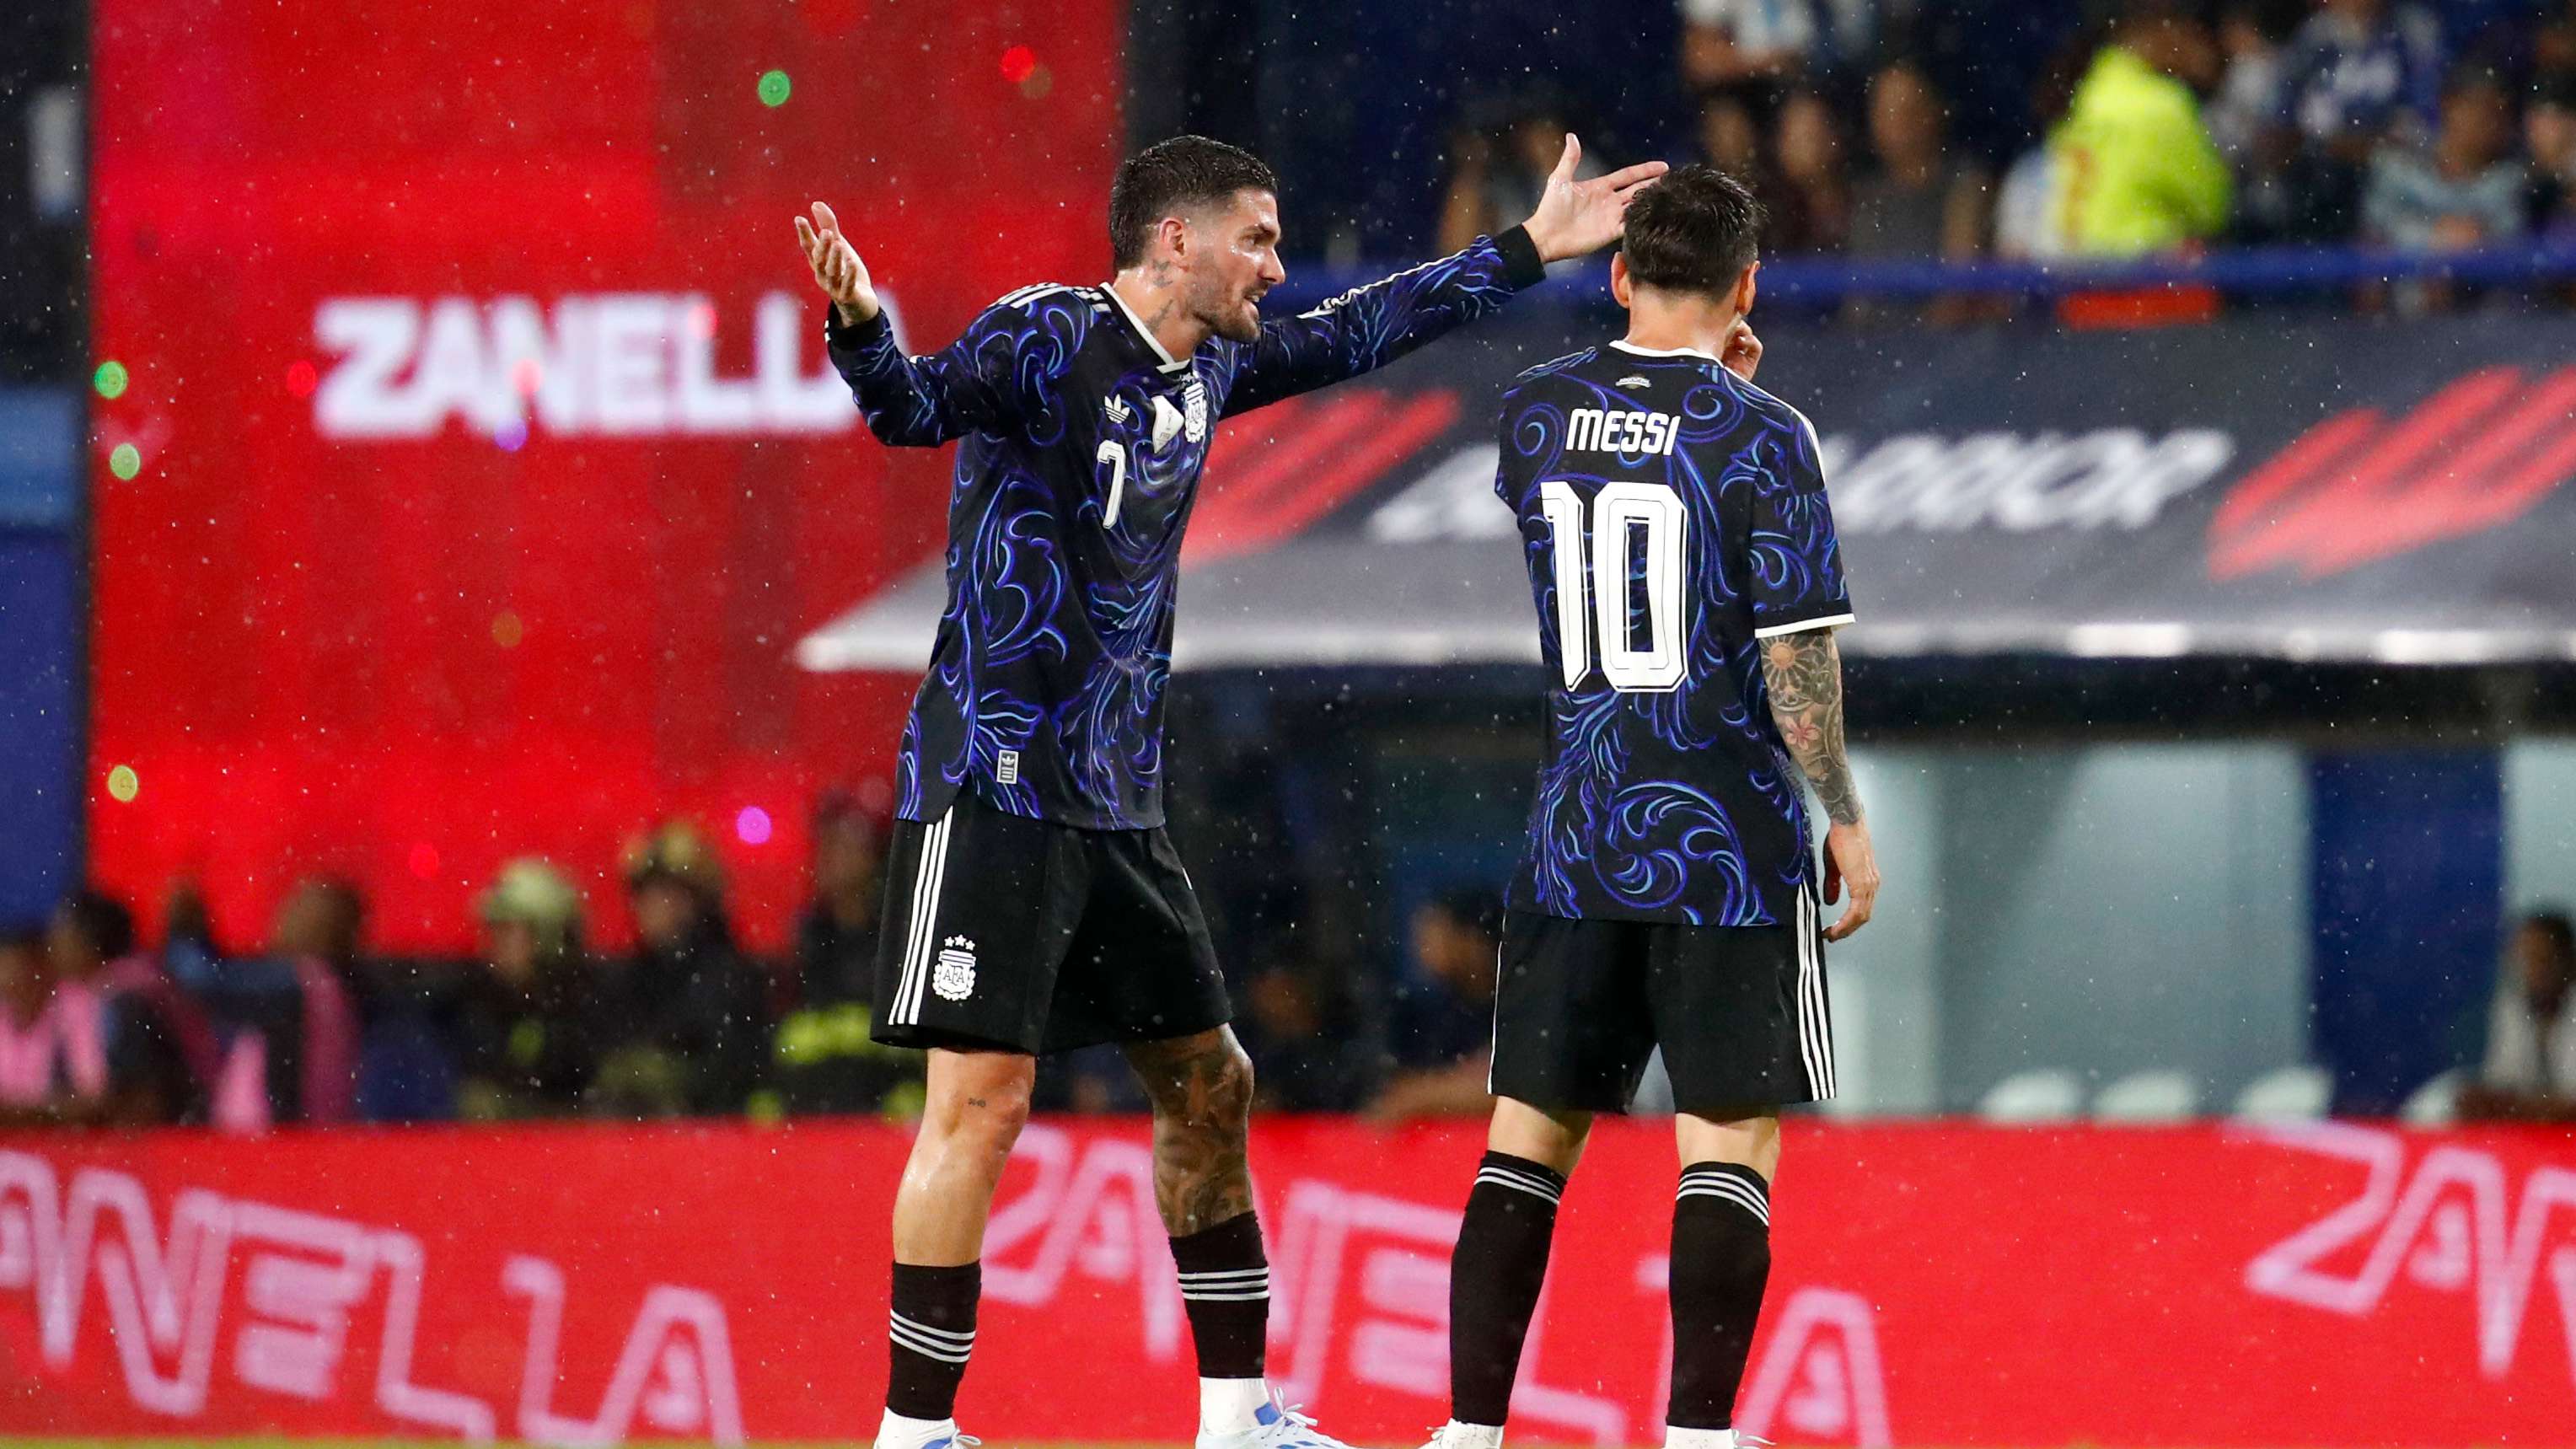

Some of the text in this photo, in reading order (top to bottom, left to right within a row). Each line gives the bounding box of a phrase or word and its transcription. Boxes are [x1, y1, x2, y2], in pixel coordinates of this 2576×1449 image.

[314, 291, 911, 437] ZANELL
[1097, 438, 1127, 529] 7
[1565, 408, 1681, 456] MESSI
[1540, 481, 1688, 693] 10
